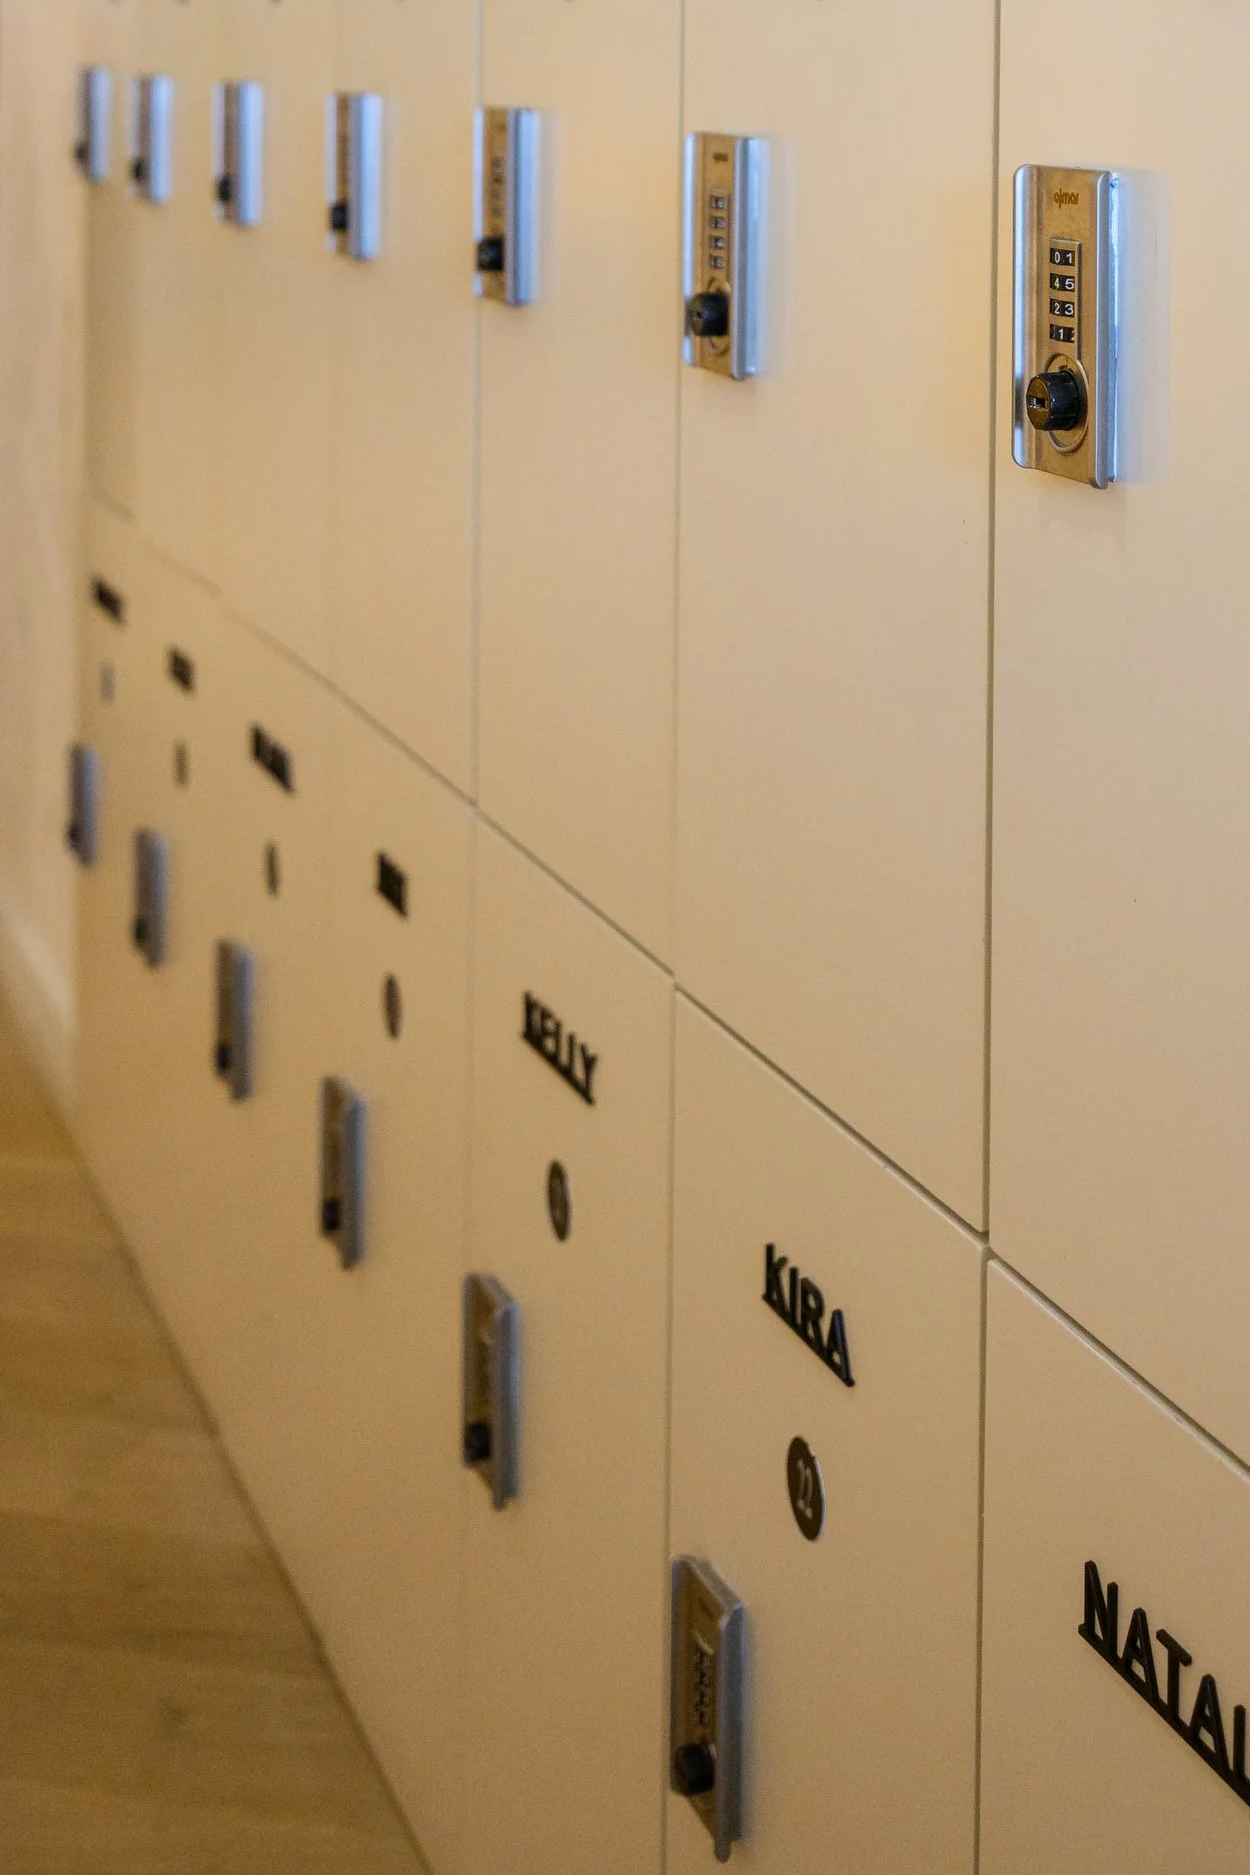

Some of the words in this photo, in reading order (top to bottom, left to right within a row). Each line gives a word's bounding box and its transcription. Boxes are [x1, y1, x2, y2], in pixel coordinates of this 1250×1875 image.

[1054, 188, 1080, 210] ojmar
[522, 990, 599, 1107] KELLY
[762, 1243, 855, 1387] KIRA
